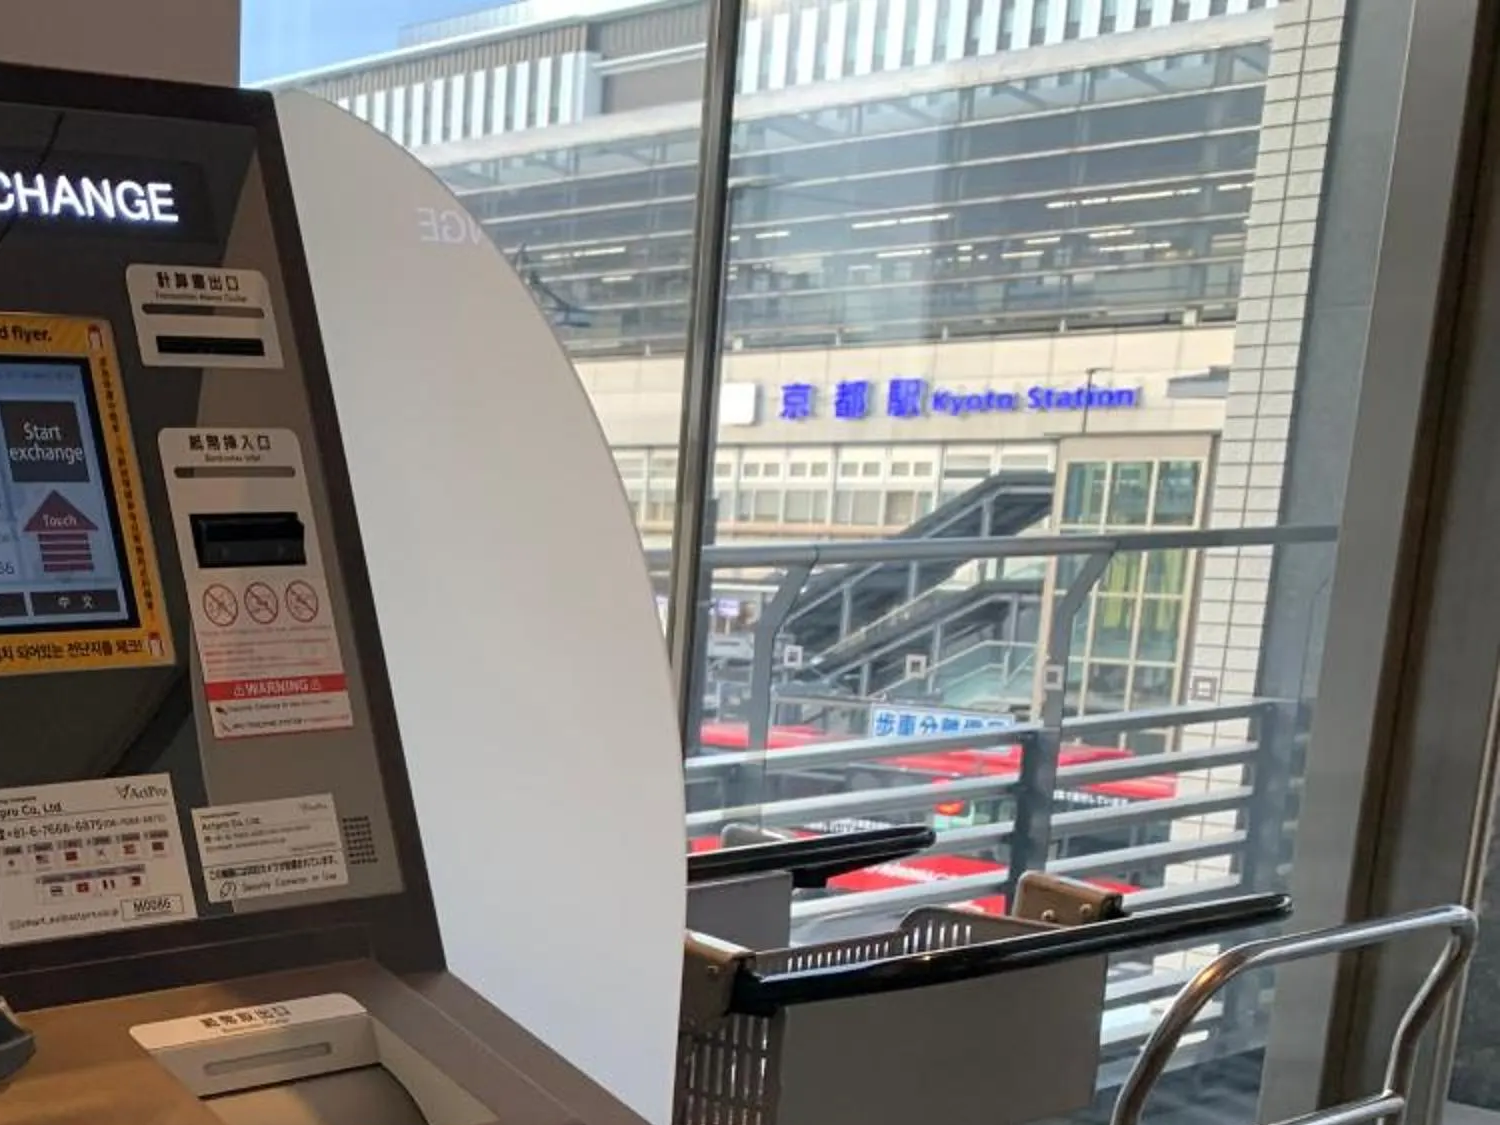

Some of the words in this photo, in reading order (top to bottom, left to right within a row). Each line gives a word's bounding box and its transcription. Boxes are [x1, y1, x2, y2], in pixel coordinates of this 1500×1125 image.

[780, 378, 928, 420] 京都駅
[931, 387, 1019, 416] Kyoto
[1026, 386, 1139, 410] Station
[22, 421, 62, 441] Start
[8, 441, 84, 465] exchange
[41, 513, 78, 528] Touch
